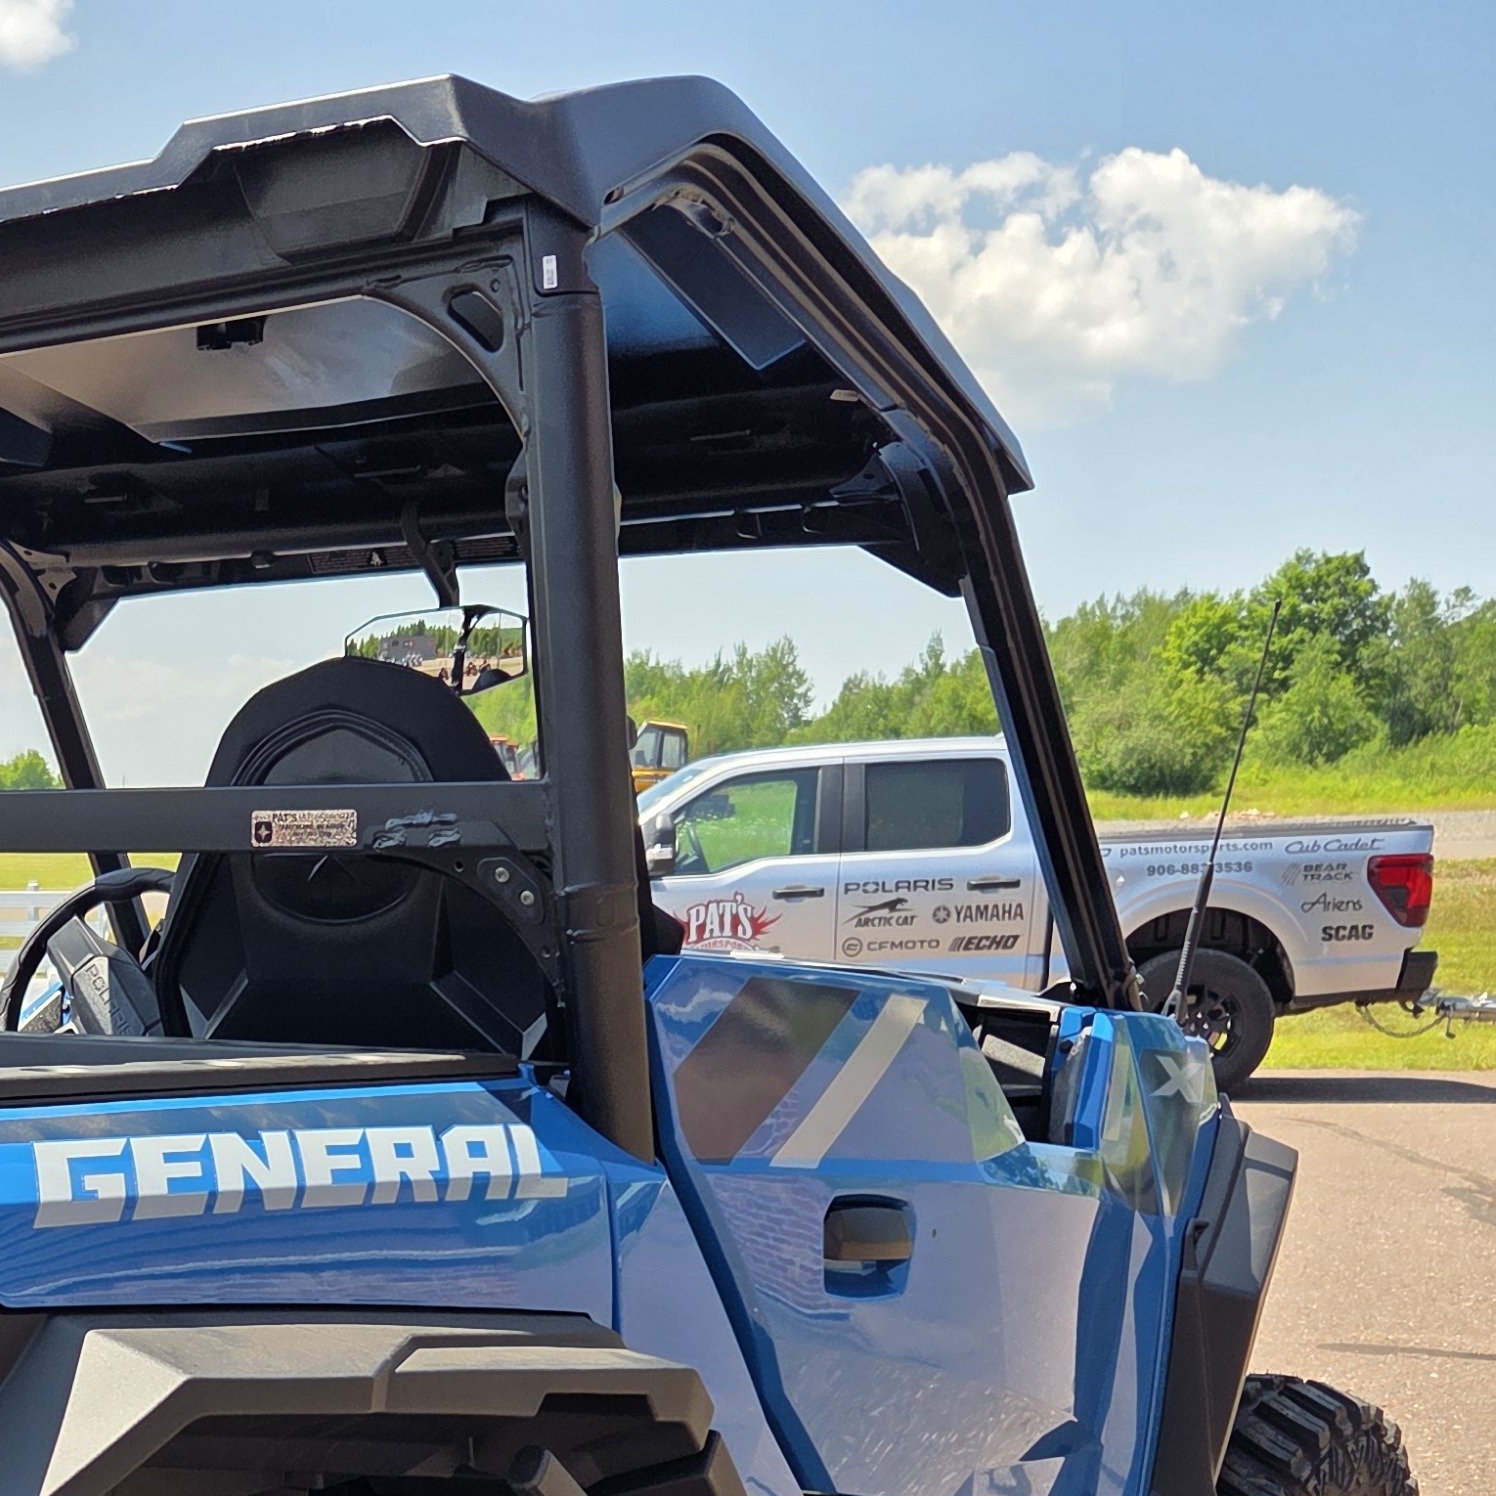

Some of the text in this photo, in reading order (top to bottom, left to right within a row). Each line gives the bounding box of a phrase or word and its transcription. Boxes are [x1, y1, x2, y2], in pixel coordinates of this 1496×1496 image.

[1120, 841, 1273, 859] patsmotorsprts.com
[1284, 838, 1386, 854] Cub Cadet
[1146, 861, 1253, 877] 906-883536
[1303, 863, 1347, 872] BEAR
[1302, 872, 1354, 881] TRACK
[844, 878, 954, 895] POLARIS
[1301, 892, 1363, 913] Ariens
[687, 892, 754, 943] PAT'S
[854, 915, 918, 928] ARCTIC CAT
[955, 903, 1024, 923] YAMAHA
[1321, 924, 1374, 942] SCAG
[866, 938, 941, 951] CFMOTO
[962, 934, 1021, 952] ECHO
[31, 1123, 570, 1229] GENERAL
